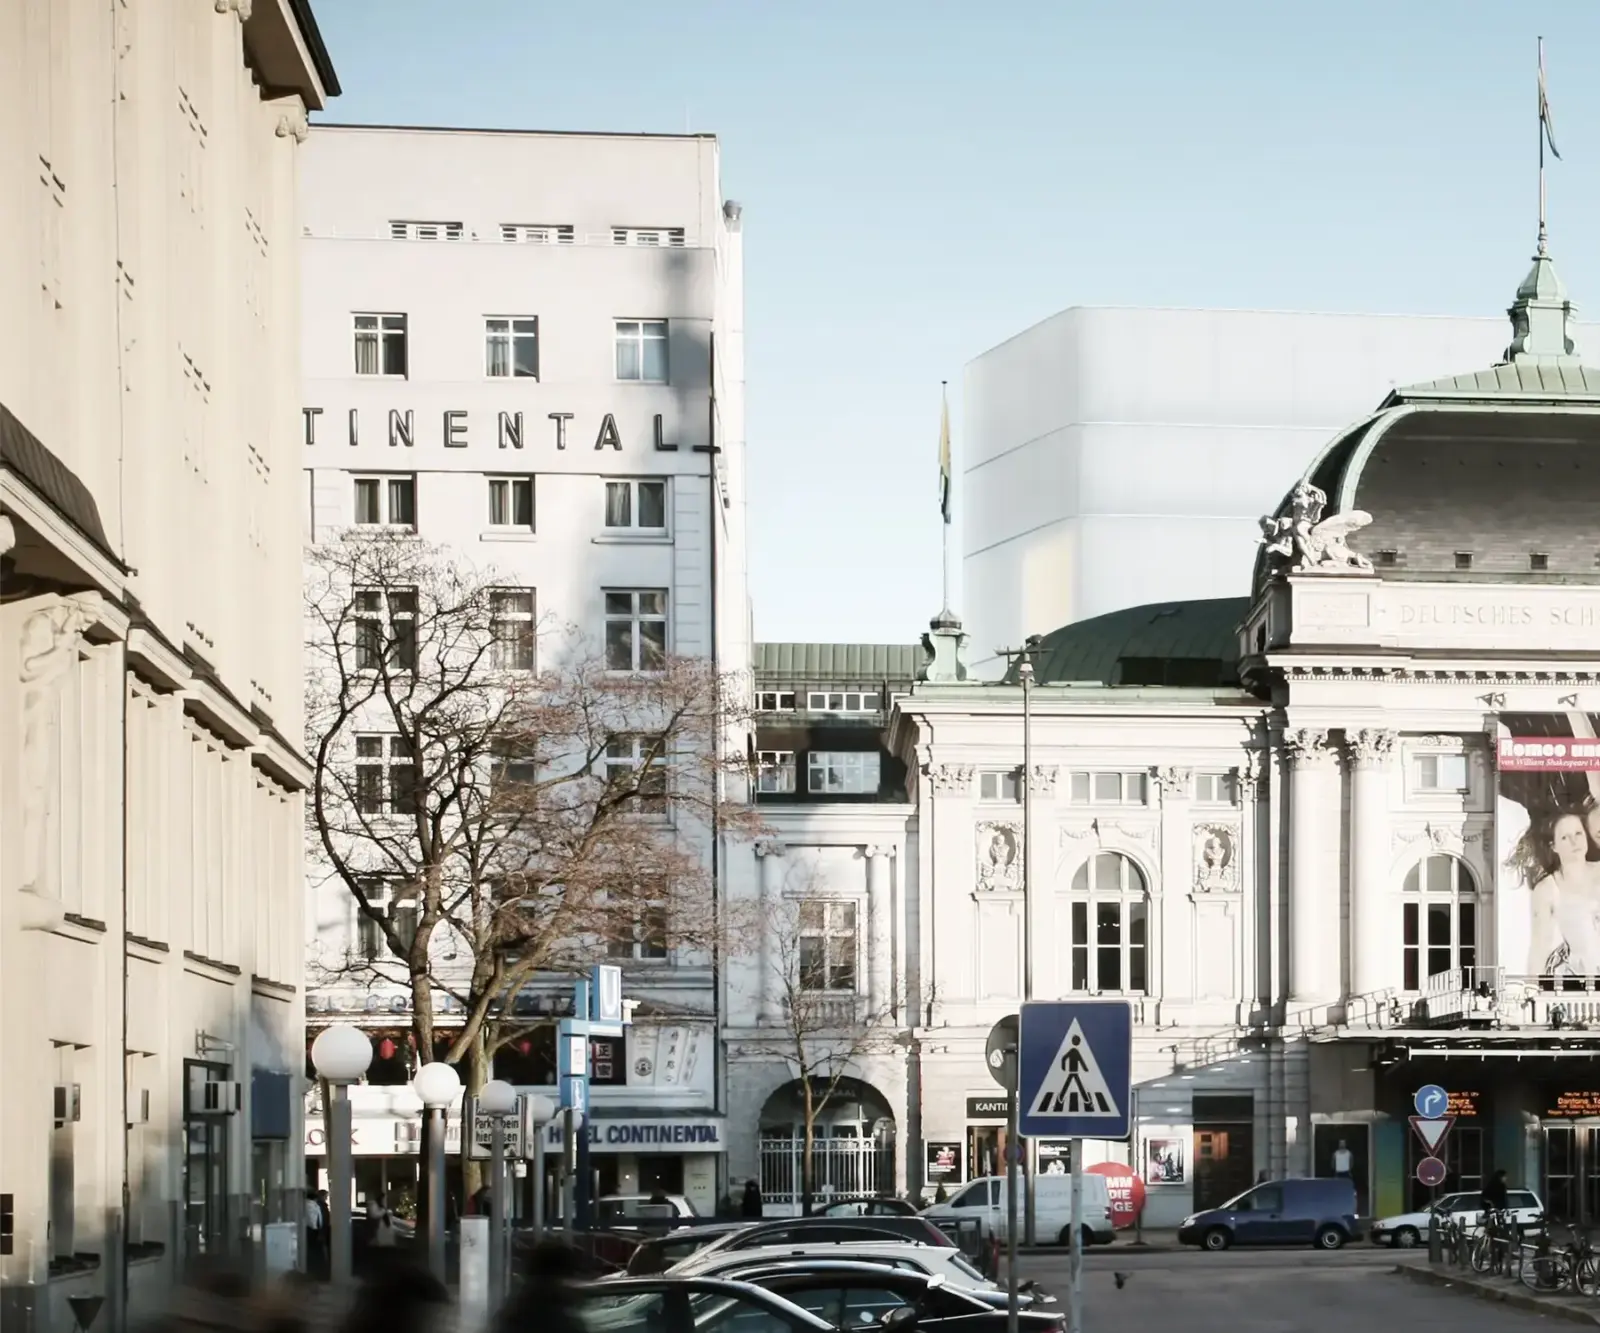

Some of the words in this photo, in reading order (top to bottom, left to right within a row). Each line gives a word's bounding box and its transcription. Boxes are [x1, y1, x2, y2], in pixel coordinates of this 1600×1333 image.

[302, 407, 678, 452] TINENTAL
[1400, 604, 1533, 625] DEUTSCHES
[1501, 740, 1566, 757] Romeo
[1516, 758, 1544, 767] William
[1545, 758, 1589, 769] Shakespeare
[975, 1102, 1019, 1112] KANTI
[549, 1126, 602, 1144] HEL
[606, 1125, 720, 1145] CONTINENTAL
[1108, 1189, 1131, 1200] DIE
